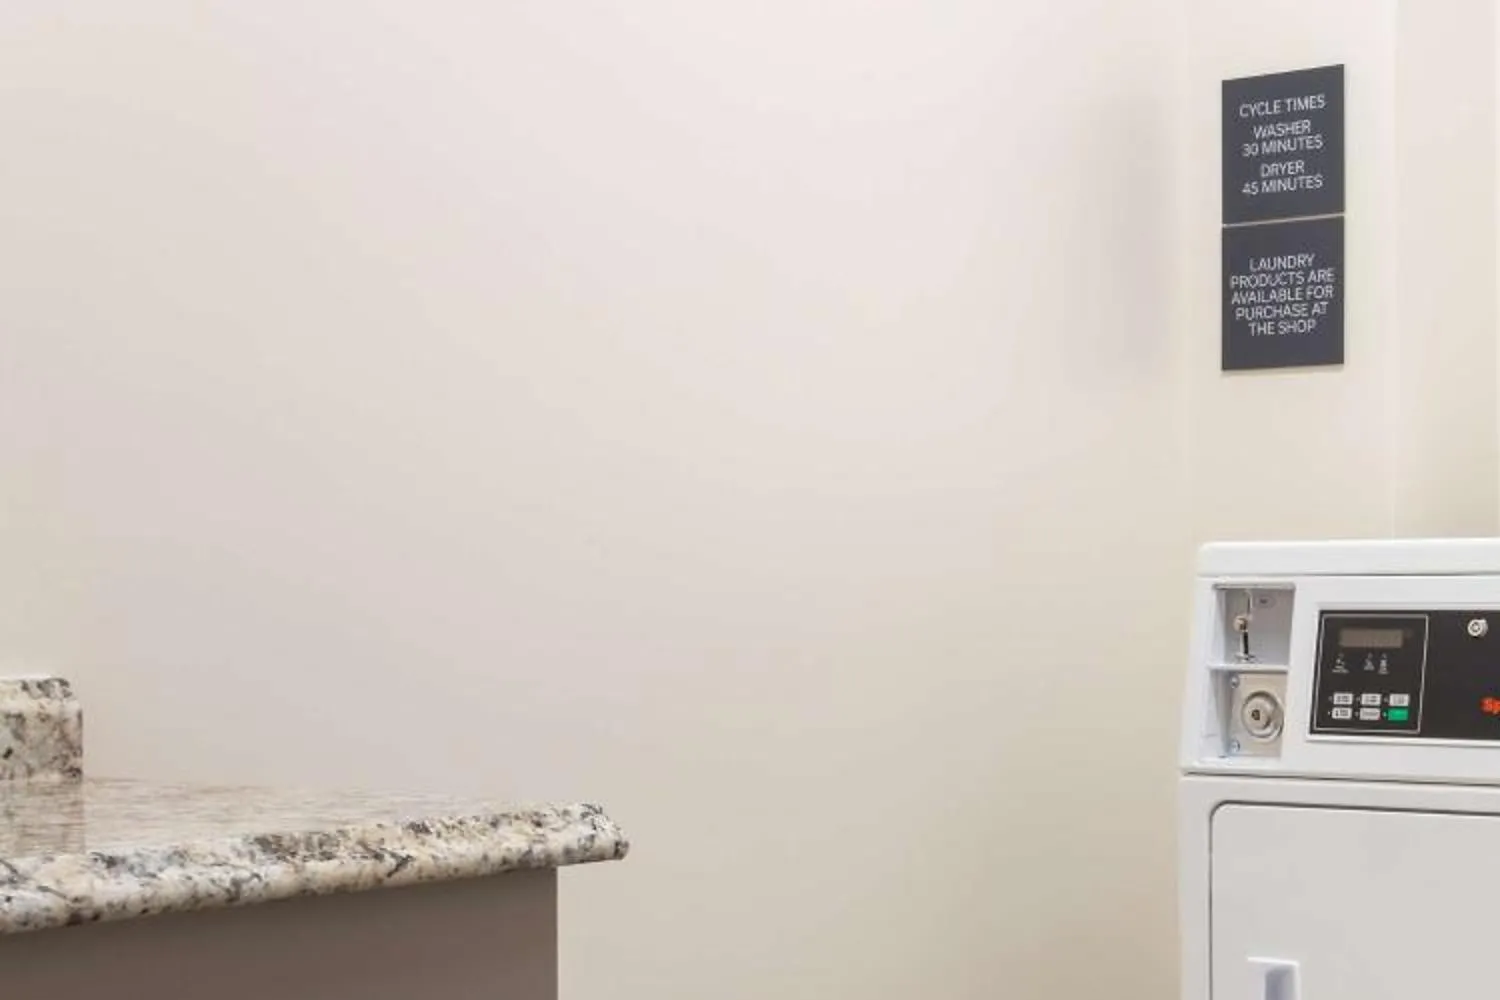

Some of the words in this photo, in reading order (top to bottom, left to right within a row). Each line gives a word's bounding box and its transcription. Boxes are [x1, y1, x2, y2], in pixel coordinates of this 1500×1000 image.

[1239, 99, 1281, 118] CYCLE
[1284, 93, 1326, 113] TIMES
[1253, 119, 1311, 140] WASHER
[1242, 142, 1259, 157] 30
[1261, 135, 1323, 155] MINUTES
[1260, 160, 1305, 178] DRYER
[1242, 181, 1259, 195] 45
[1261, 175, 1323, 194] MINUTES
[1249, 253, 1315, 271] LAUNDRY
[1230, 271, 1304, 289] PRODUCTS
[1307, 267, 1336, 284] ARE
[1231, 287, 1303, 305] AVAILABLE
[1306, 284, 1333, 300] FOR
[1235, 303, 1309, 321] PURCHASE
[1311, 301, 1328, 316] AT
[1248, 321, 1276, 336] THE
[1278, 318, 1317, 334] SHOP
